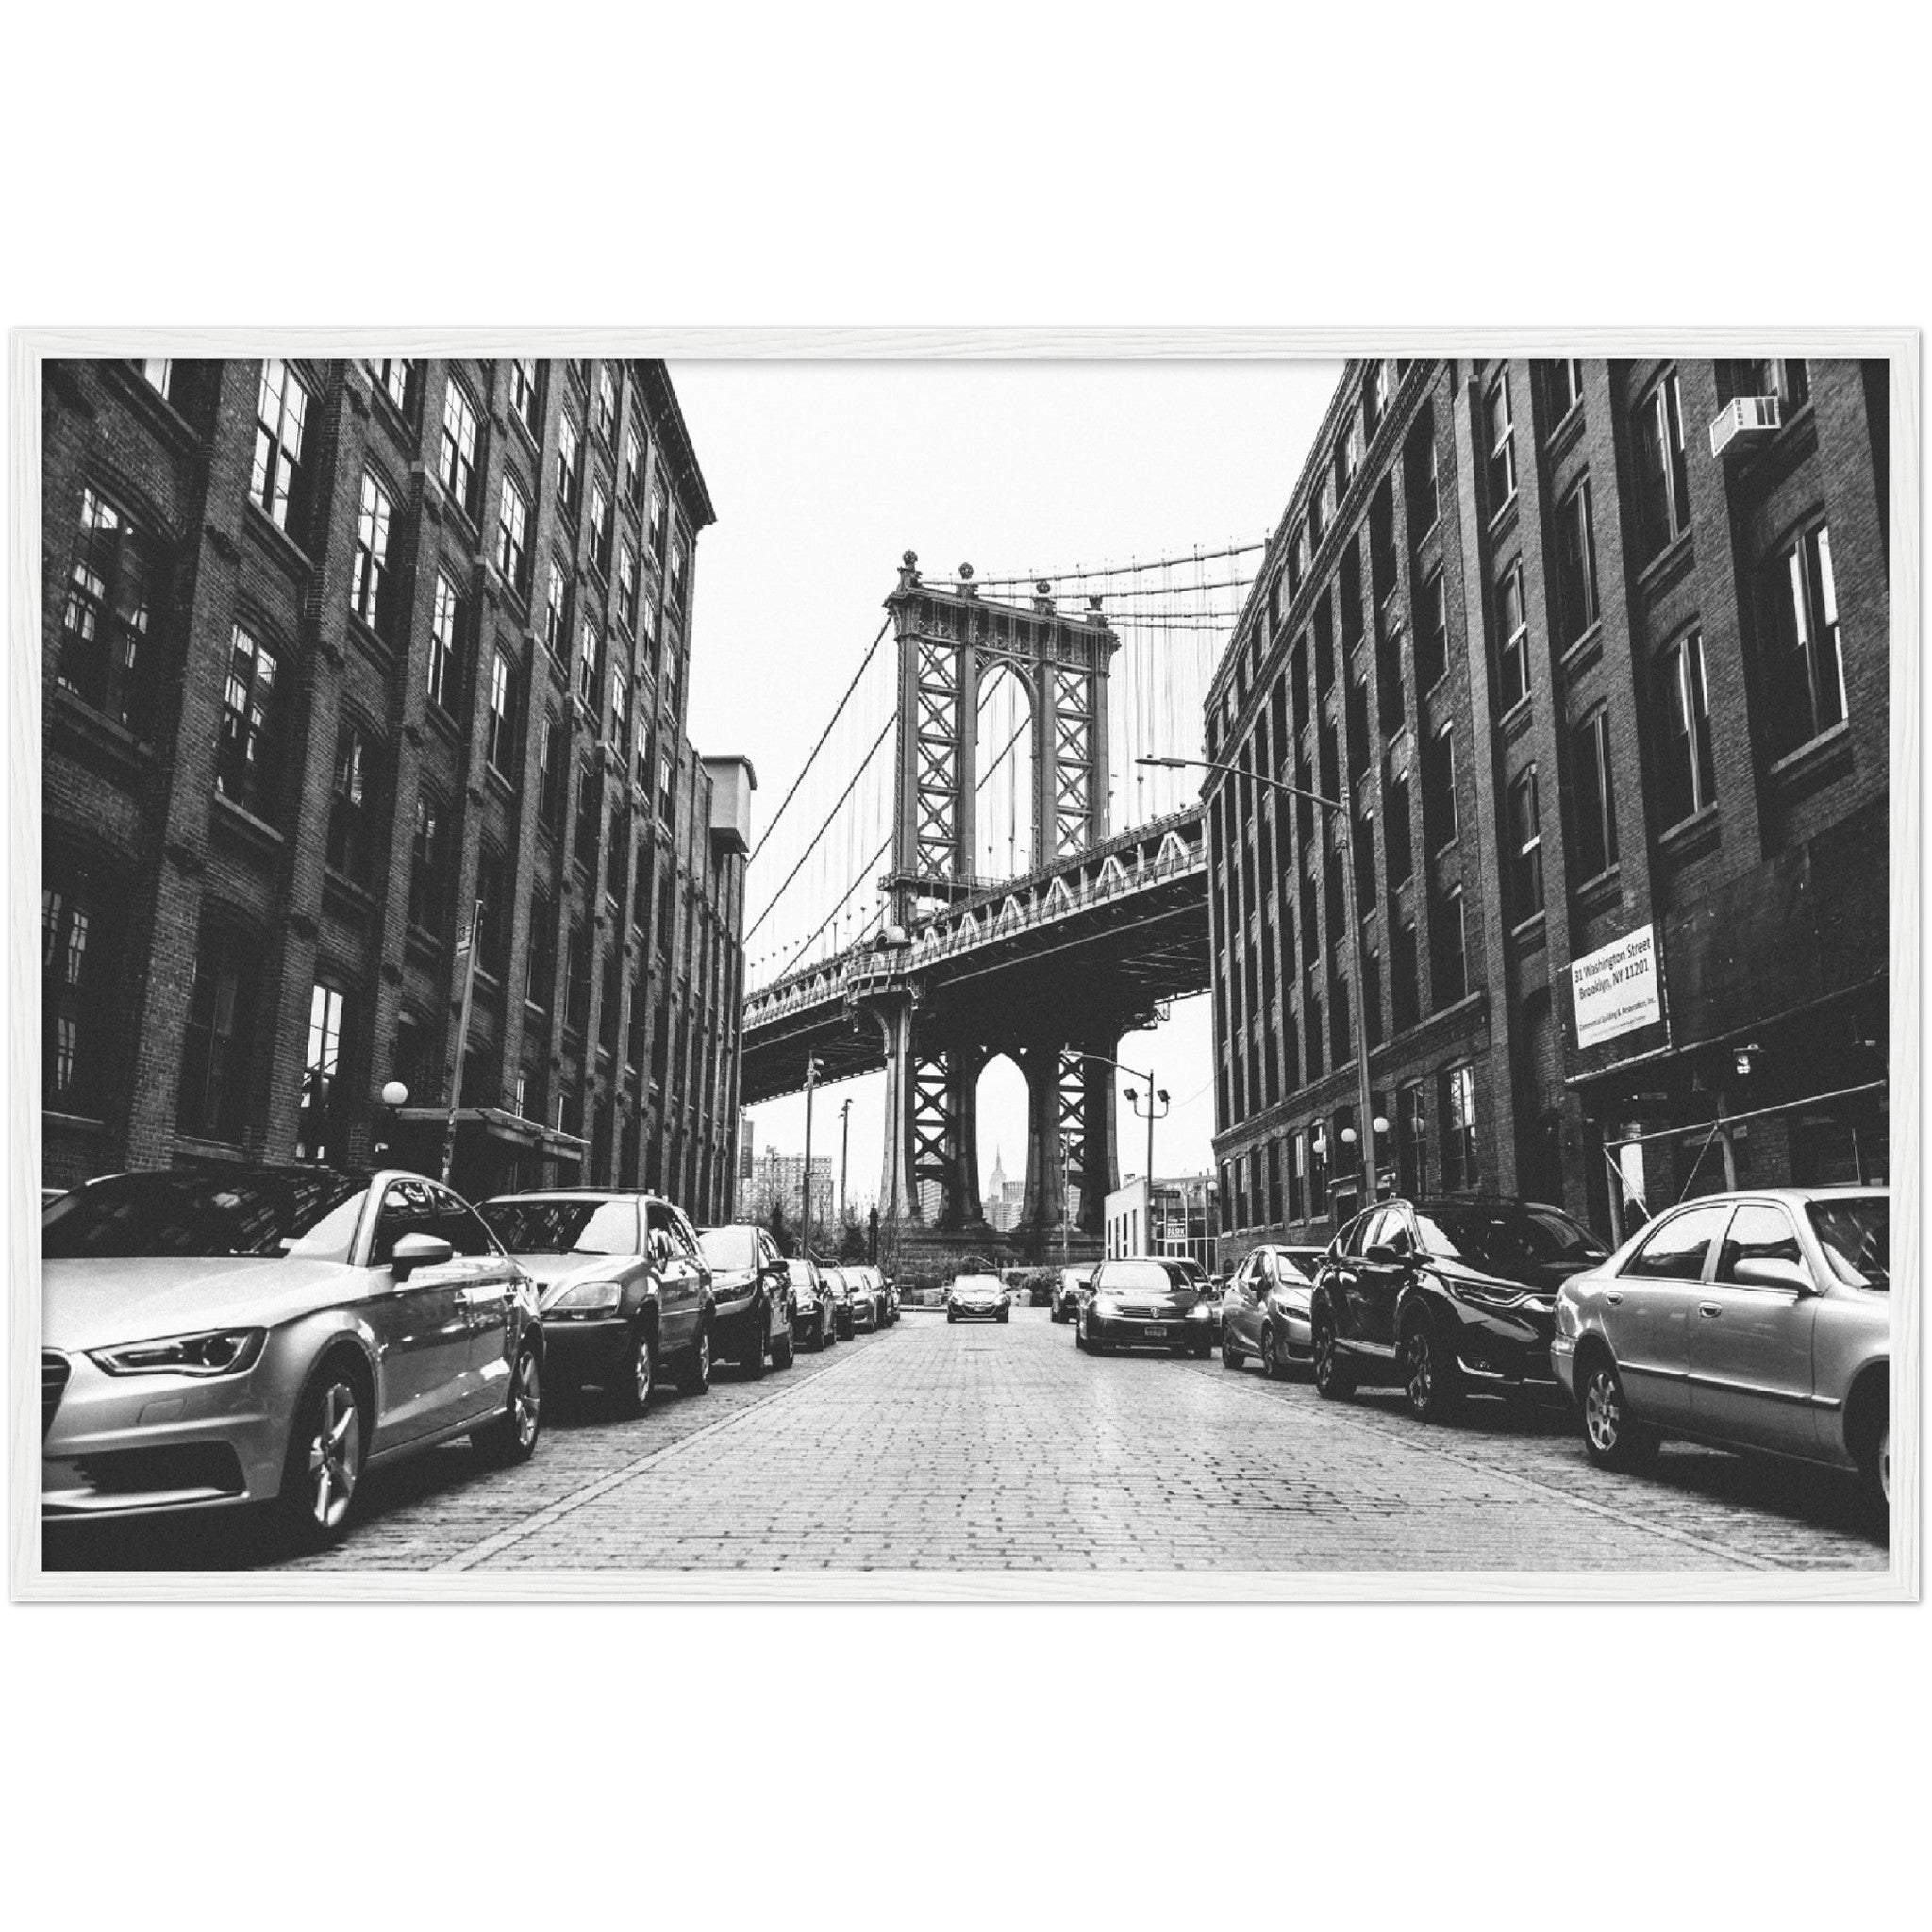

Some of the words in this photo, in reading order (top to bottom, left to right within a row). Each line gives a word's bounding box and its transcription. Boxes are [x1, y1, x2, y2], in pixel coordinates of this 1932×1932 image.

[1575, 969, 1583, 983] 31
[1584, 950, 1625, 978] Washington
[1626, 937, 1651, 958] Street
[1612, 969, 1623, 986] NY
[1625, 958, 1649, 980] 11201
[1167, 1227, 1185, 1236] PARK
